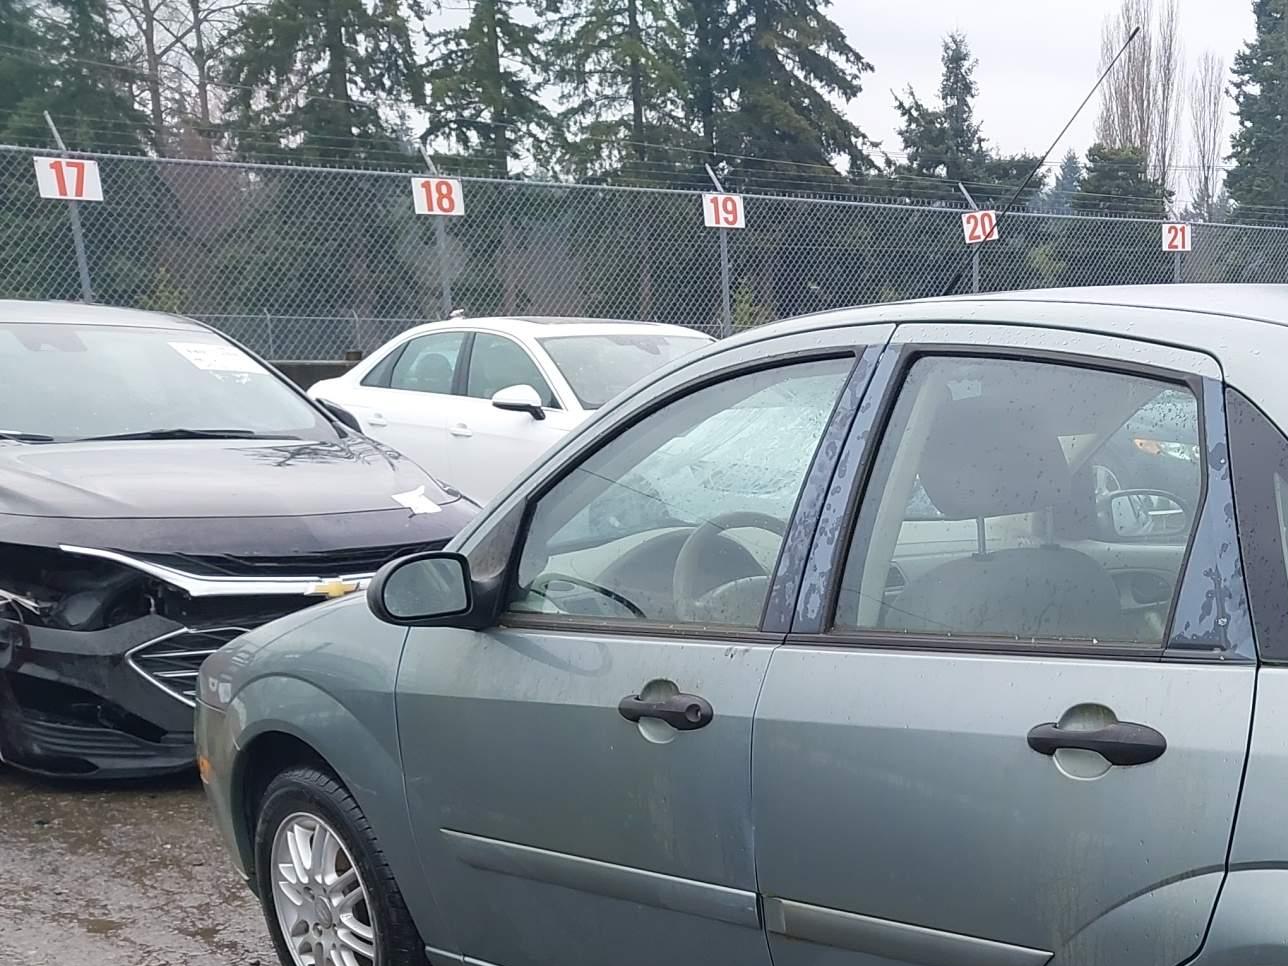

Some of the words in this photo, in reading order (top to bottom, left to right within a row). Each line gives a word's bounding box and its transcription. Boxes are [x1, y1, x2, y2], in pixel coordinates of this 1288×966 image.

[49, 160, 85, 197] 17
[421, 180, 455, 213] 18
[710, 196, 738, 225] 19
[966, 212, 994, 240] 20
[1167, 225, 1186, 249] 21
